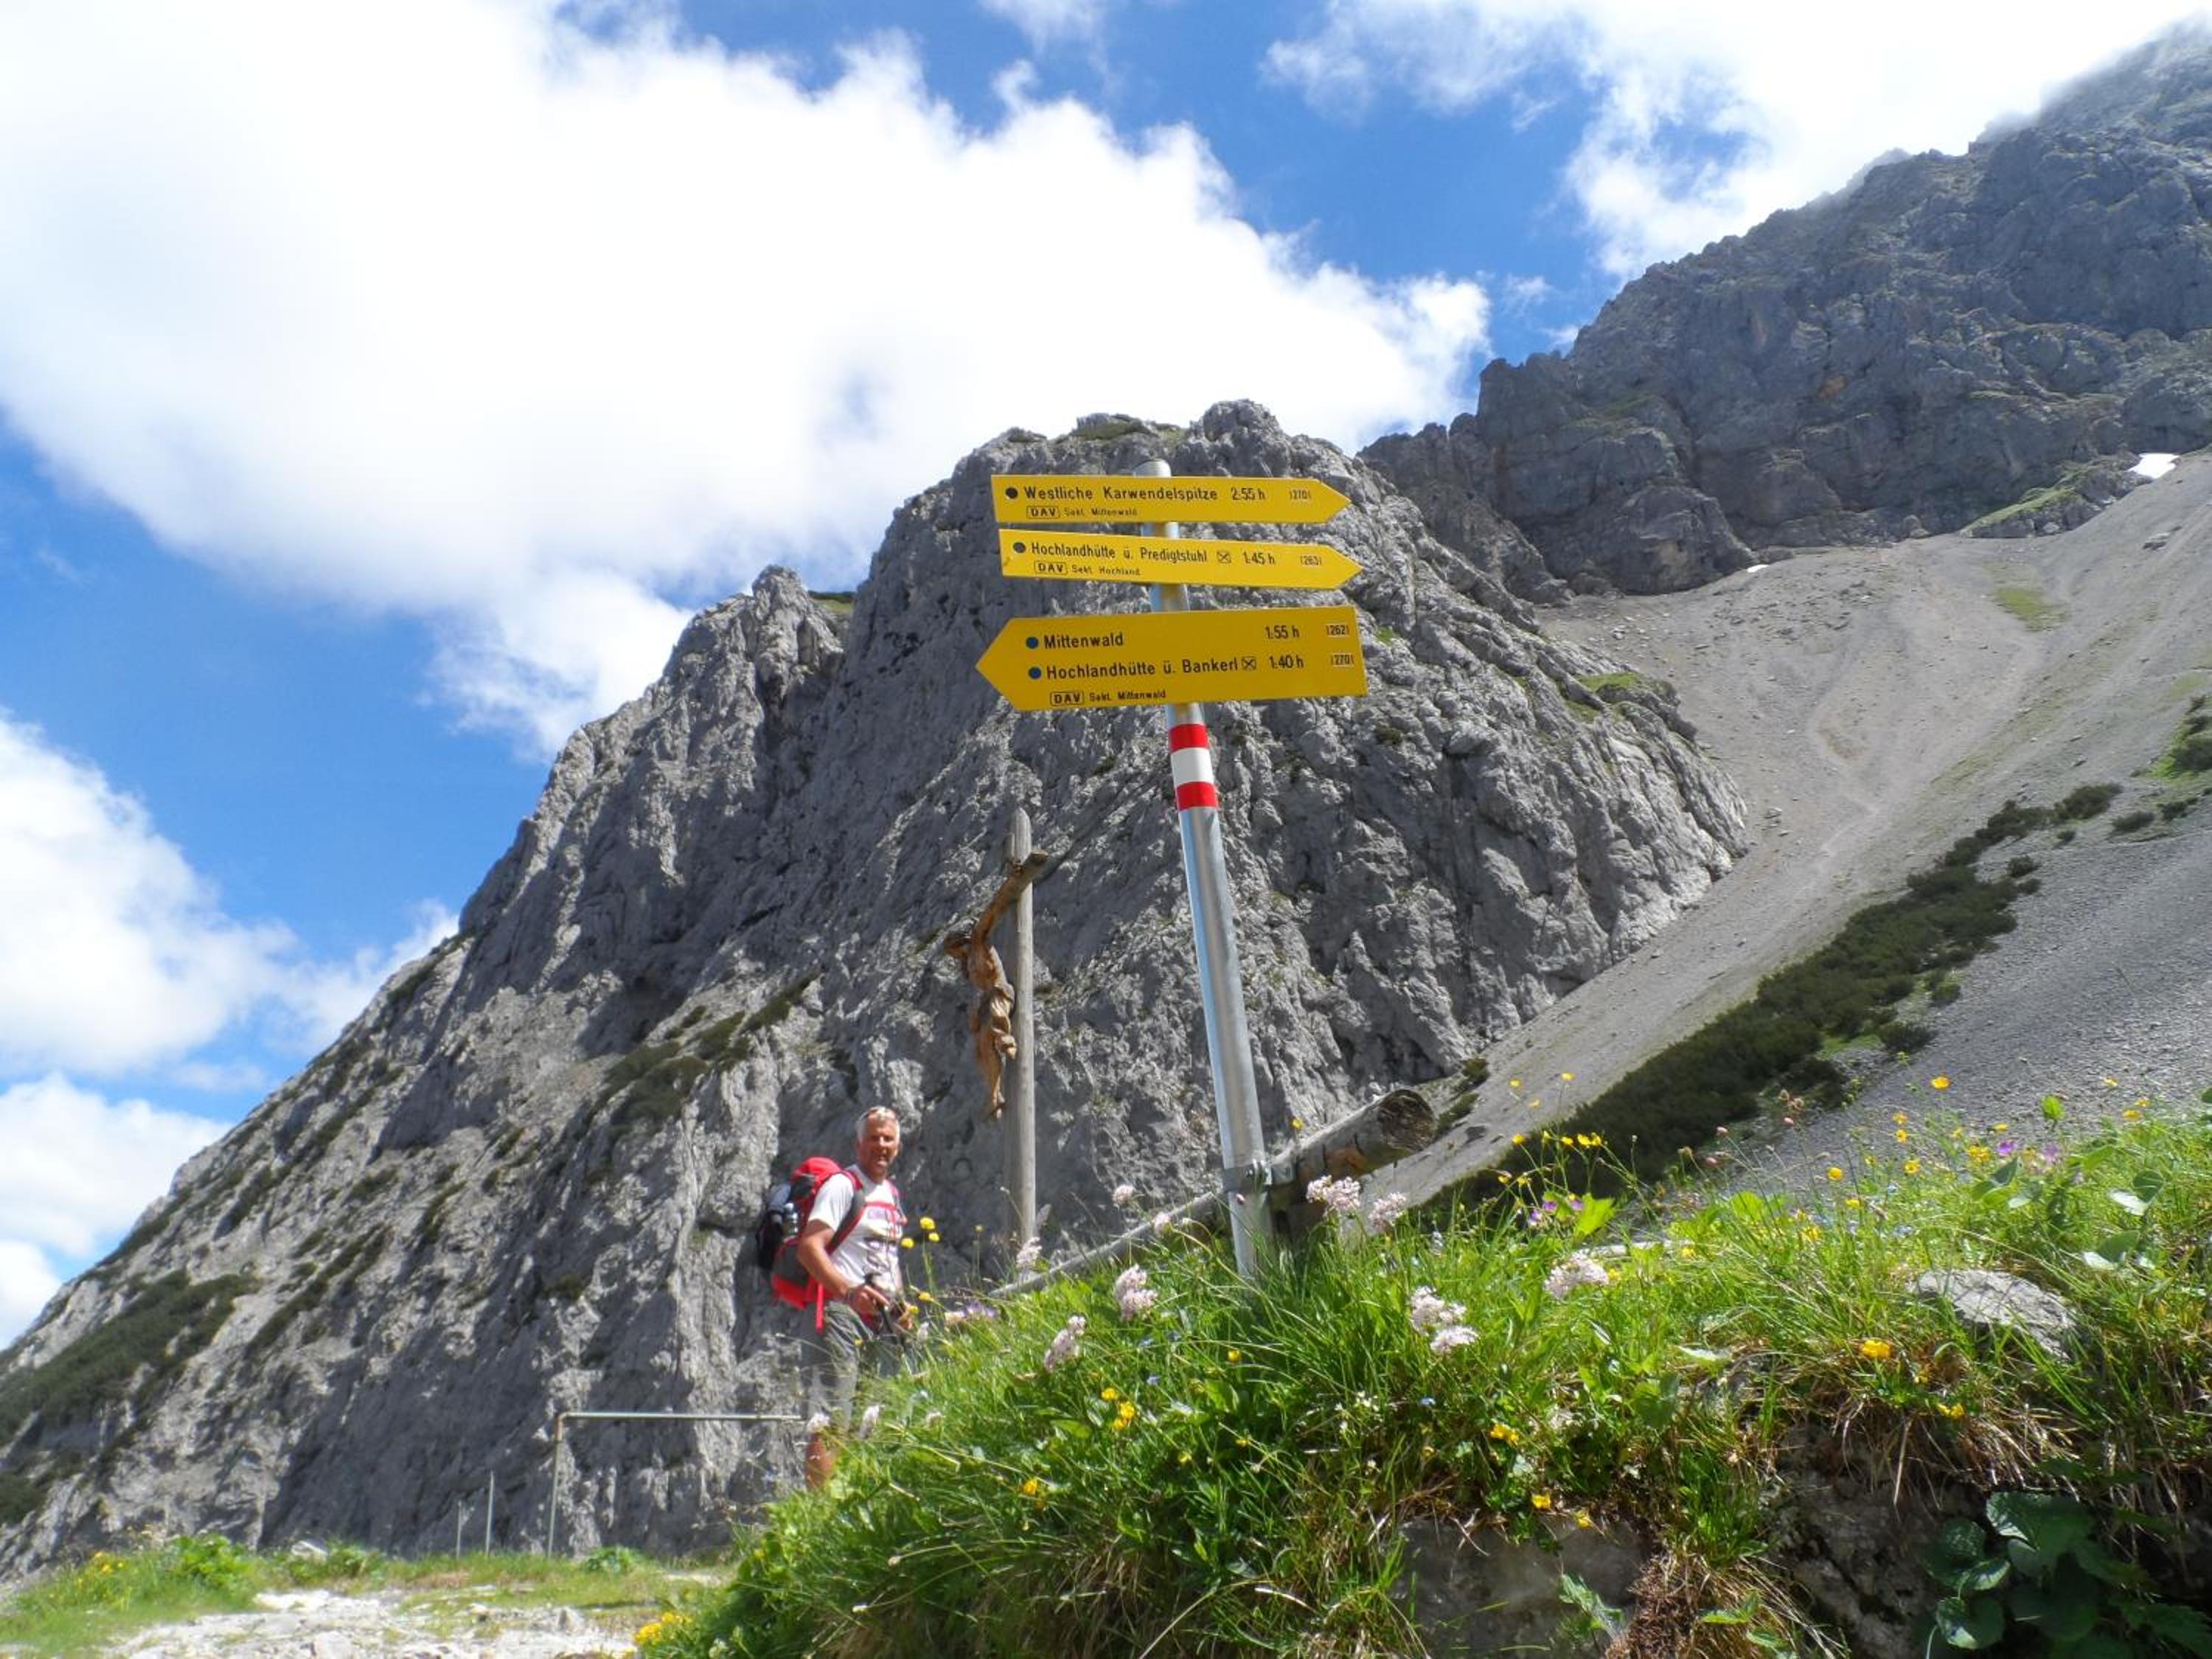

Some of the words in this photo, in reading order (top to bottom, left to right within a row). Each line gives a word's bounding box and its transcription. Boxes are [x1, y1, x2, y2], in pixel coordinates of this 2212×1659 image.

[1024, 487, 1093, 499] Westliche
[1103, 486, 1217, 501] Karwendelspitze
[1257, 488, 1265, 500] h
[1031, 507, 1056, 517] DAV
[1032, 543, 1116, 559] Hochlandhütte
[1141, 547, 1207, 563] Predigtstuhl
[1267, 552, 1275, 564] h
[1037, 563, 1063, 573] DAV
[1099, 566, 1140, 576] Hochland
[1044, 633, 1124, 649] Mittenwald
[1291, 626, 1299, 638] h
[1046, 662, 1155, 680] Hochlandhütte
[1183, 657, 1237, 673] Bankerl
[1295, 656, 1304, 669] h
[1054, 693, 1081, 704] DAV
[1118, 689, 1166, 700] Mittenwald
